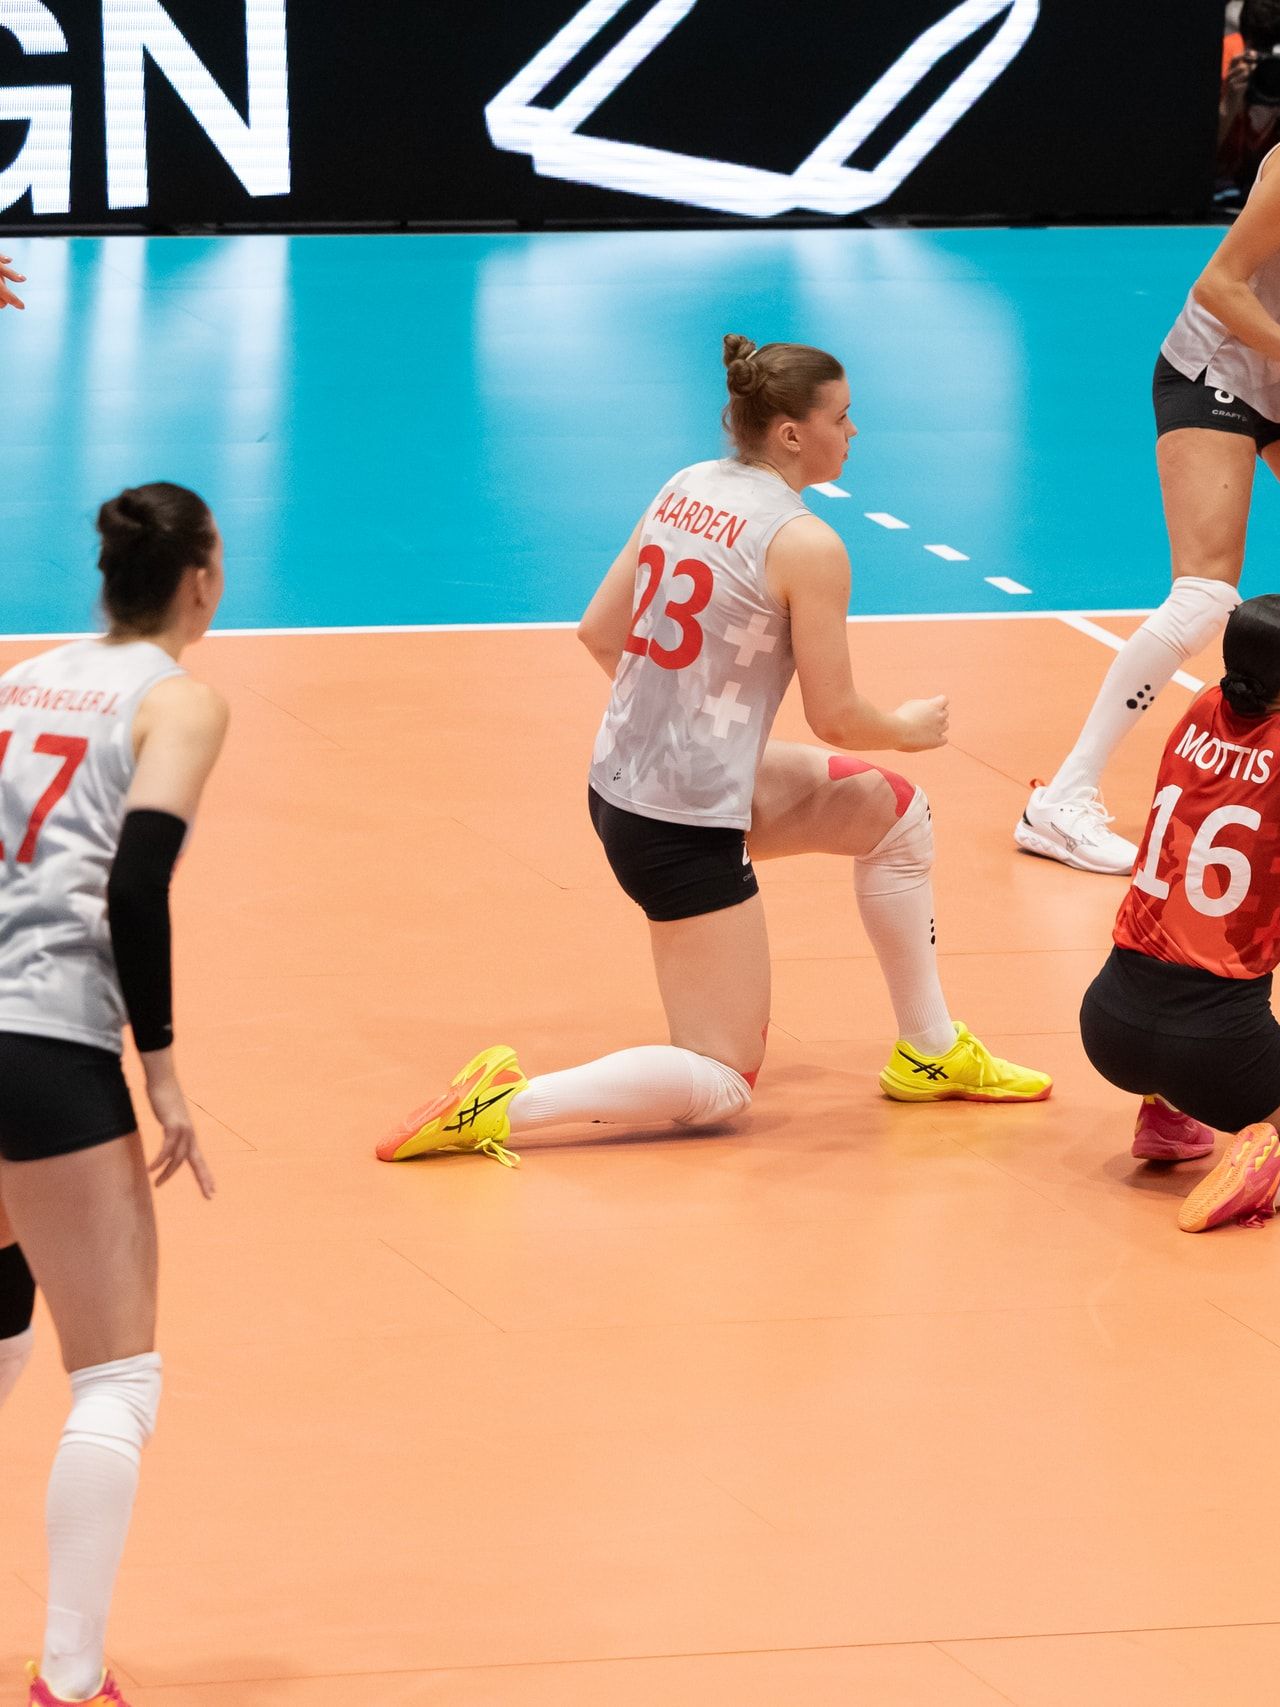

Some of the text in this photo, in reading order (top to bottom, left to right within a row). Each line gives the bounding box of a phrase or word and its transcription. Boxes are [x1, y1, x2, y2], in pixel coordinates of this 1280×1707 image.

[0, 0, 291, 215] GN
[653, 492, 747, 549] AARDEN
[624, 544, 714, 670] 23
[1174, 723, 1274, 784] MOTTIS
[1132, 784, 1262, 918] 16
